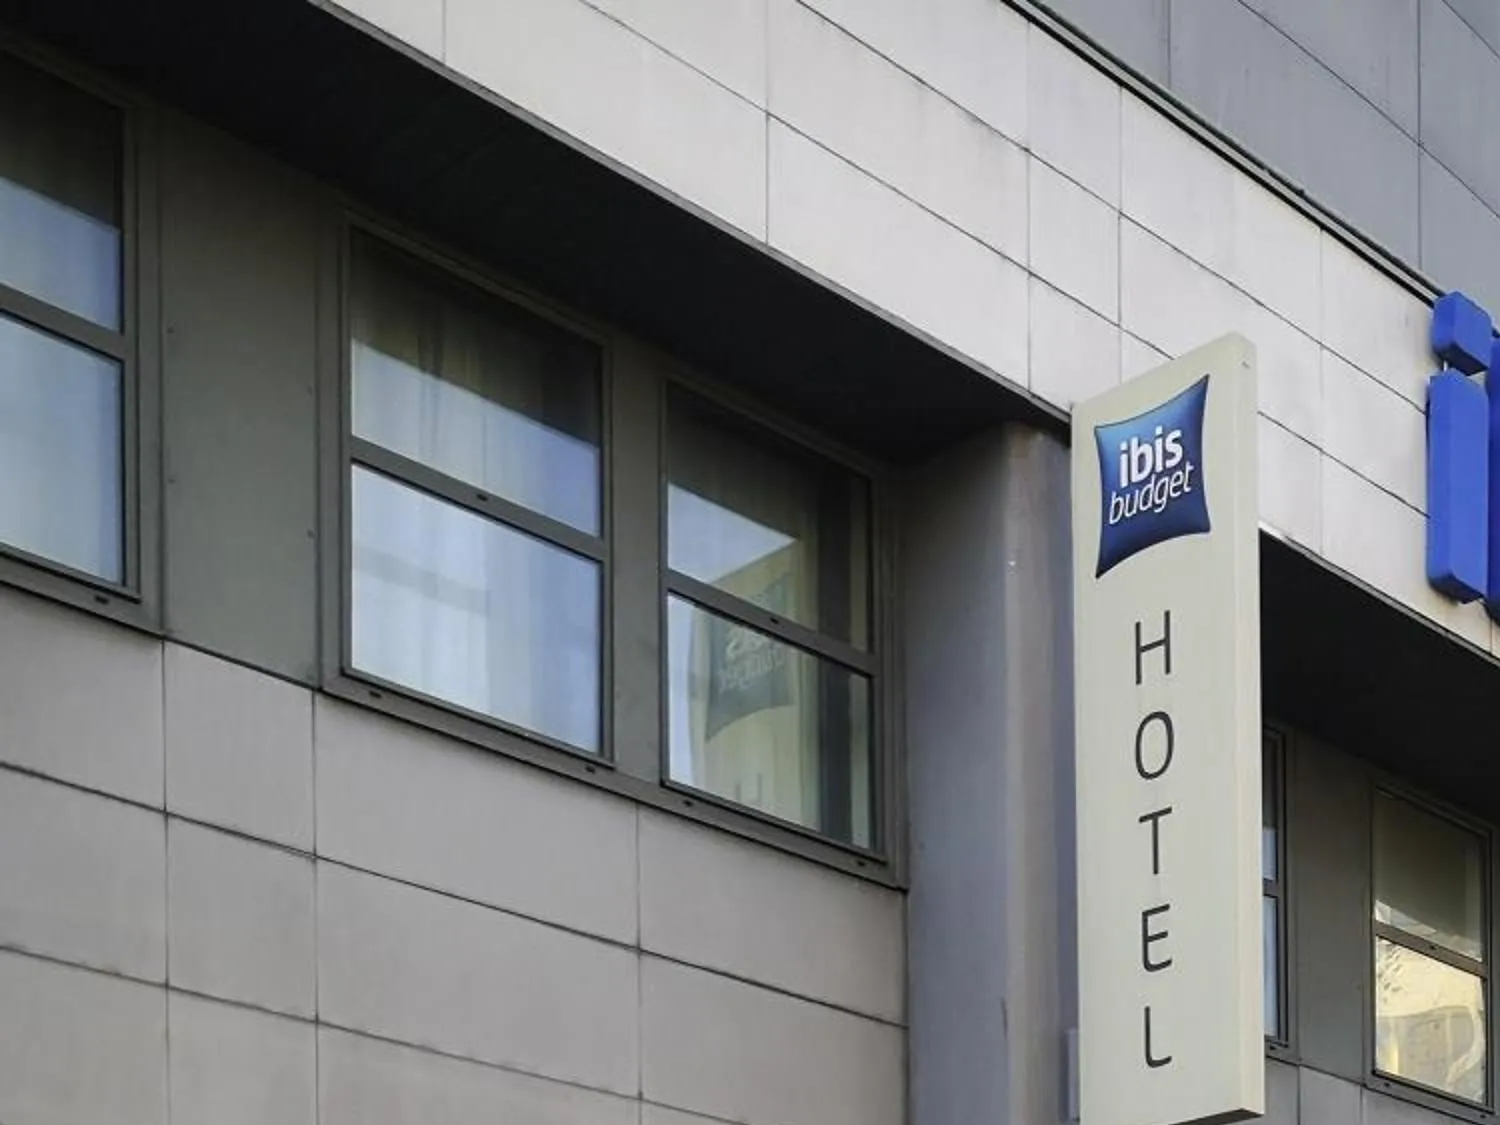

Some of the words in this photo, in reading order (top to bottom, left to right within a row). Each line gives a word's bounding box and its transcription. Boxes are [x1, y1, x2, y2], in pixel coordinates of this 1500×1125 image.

[1118, 425, 1183, 488] ibis
[1109, 461, 1194, 525] budget
[1134, 609, 1175, 1069] HOTEL
